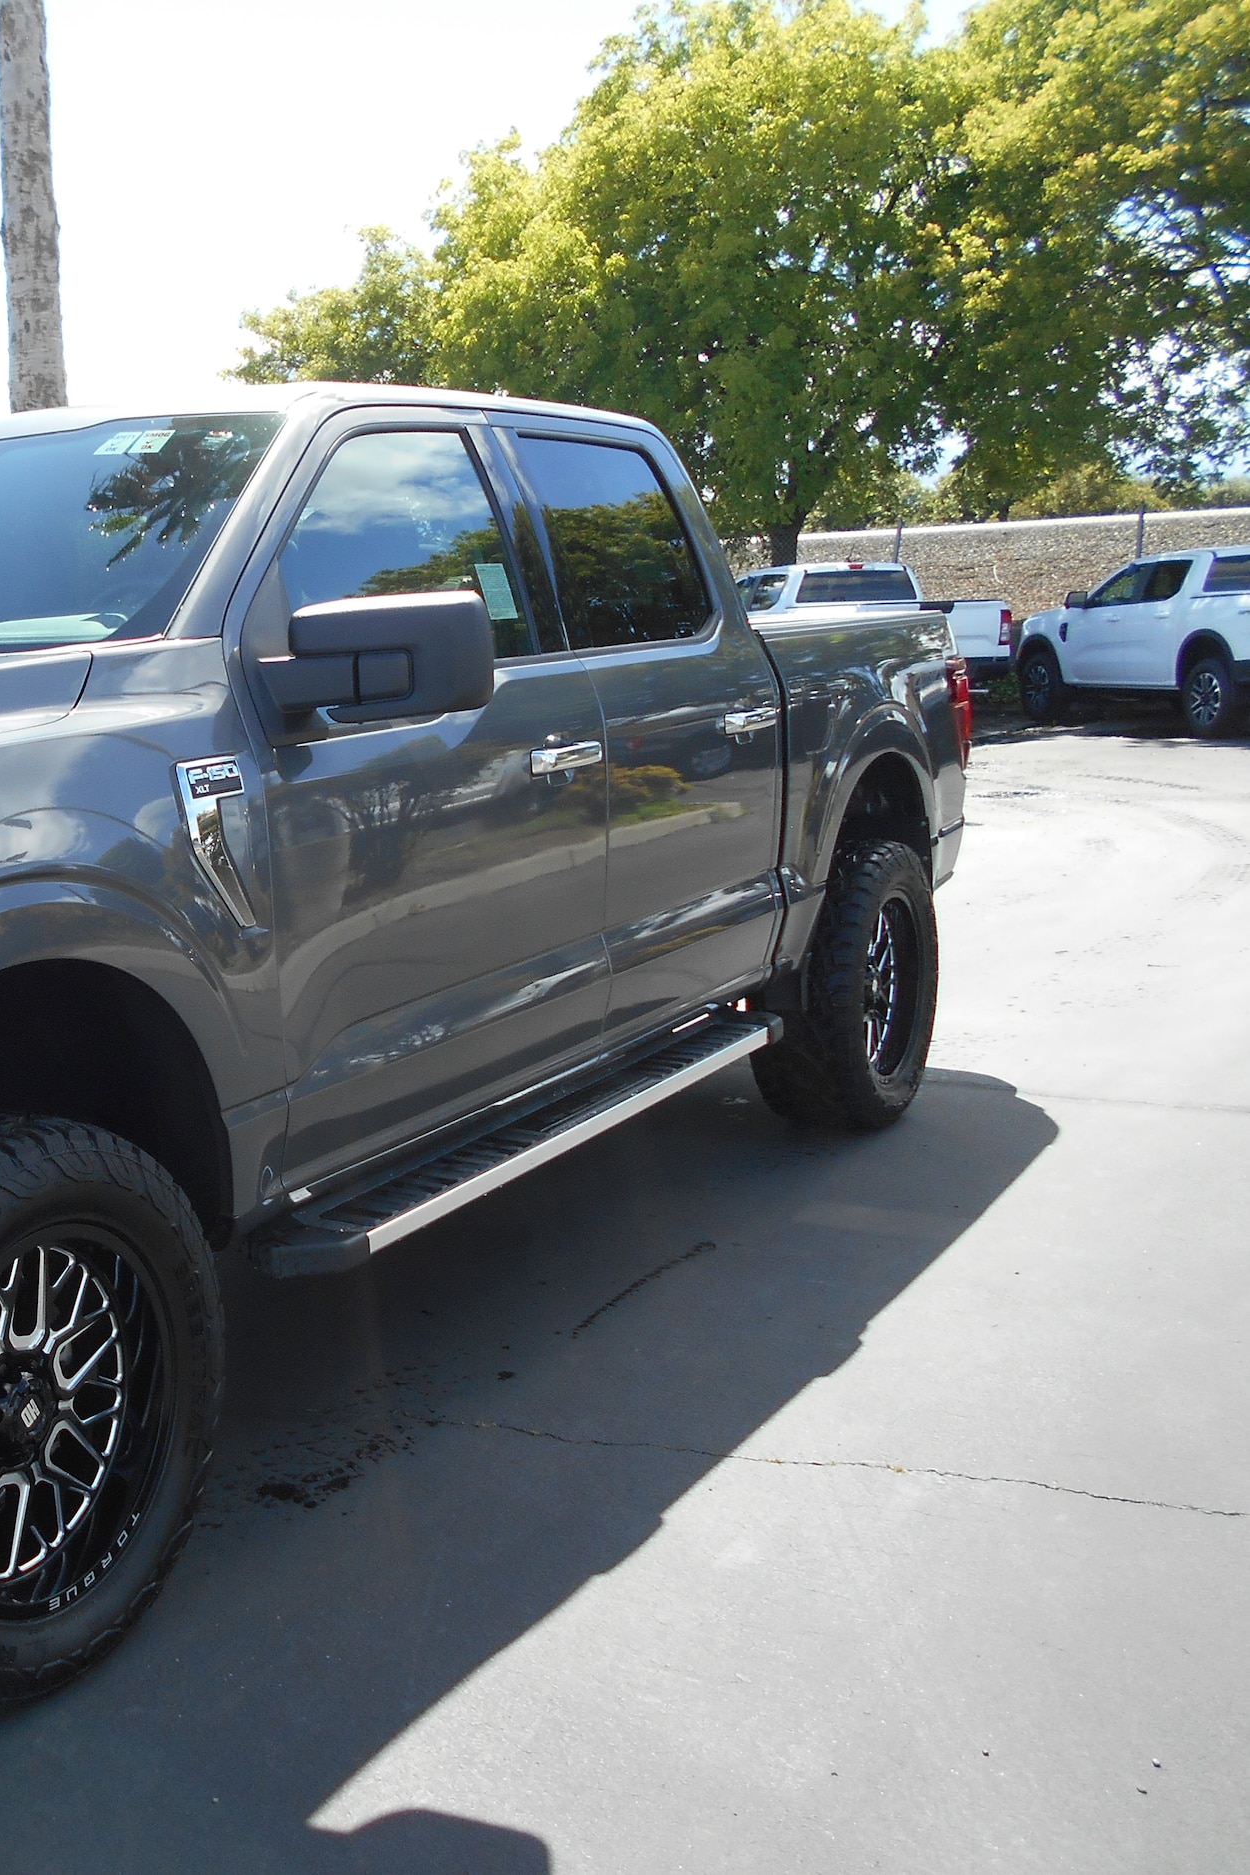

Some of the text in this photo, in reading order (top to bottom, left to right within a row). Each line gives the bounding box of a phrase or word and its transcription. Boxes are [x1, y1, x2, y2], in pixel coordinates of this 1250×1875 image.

[188, 763, 239, 784] F-150
[195, 784, 210, 794] XLT
[48, 1512, 141, 1612] TORQUE
